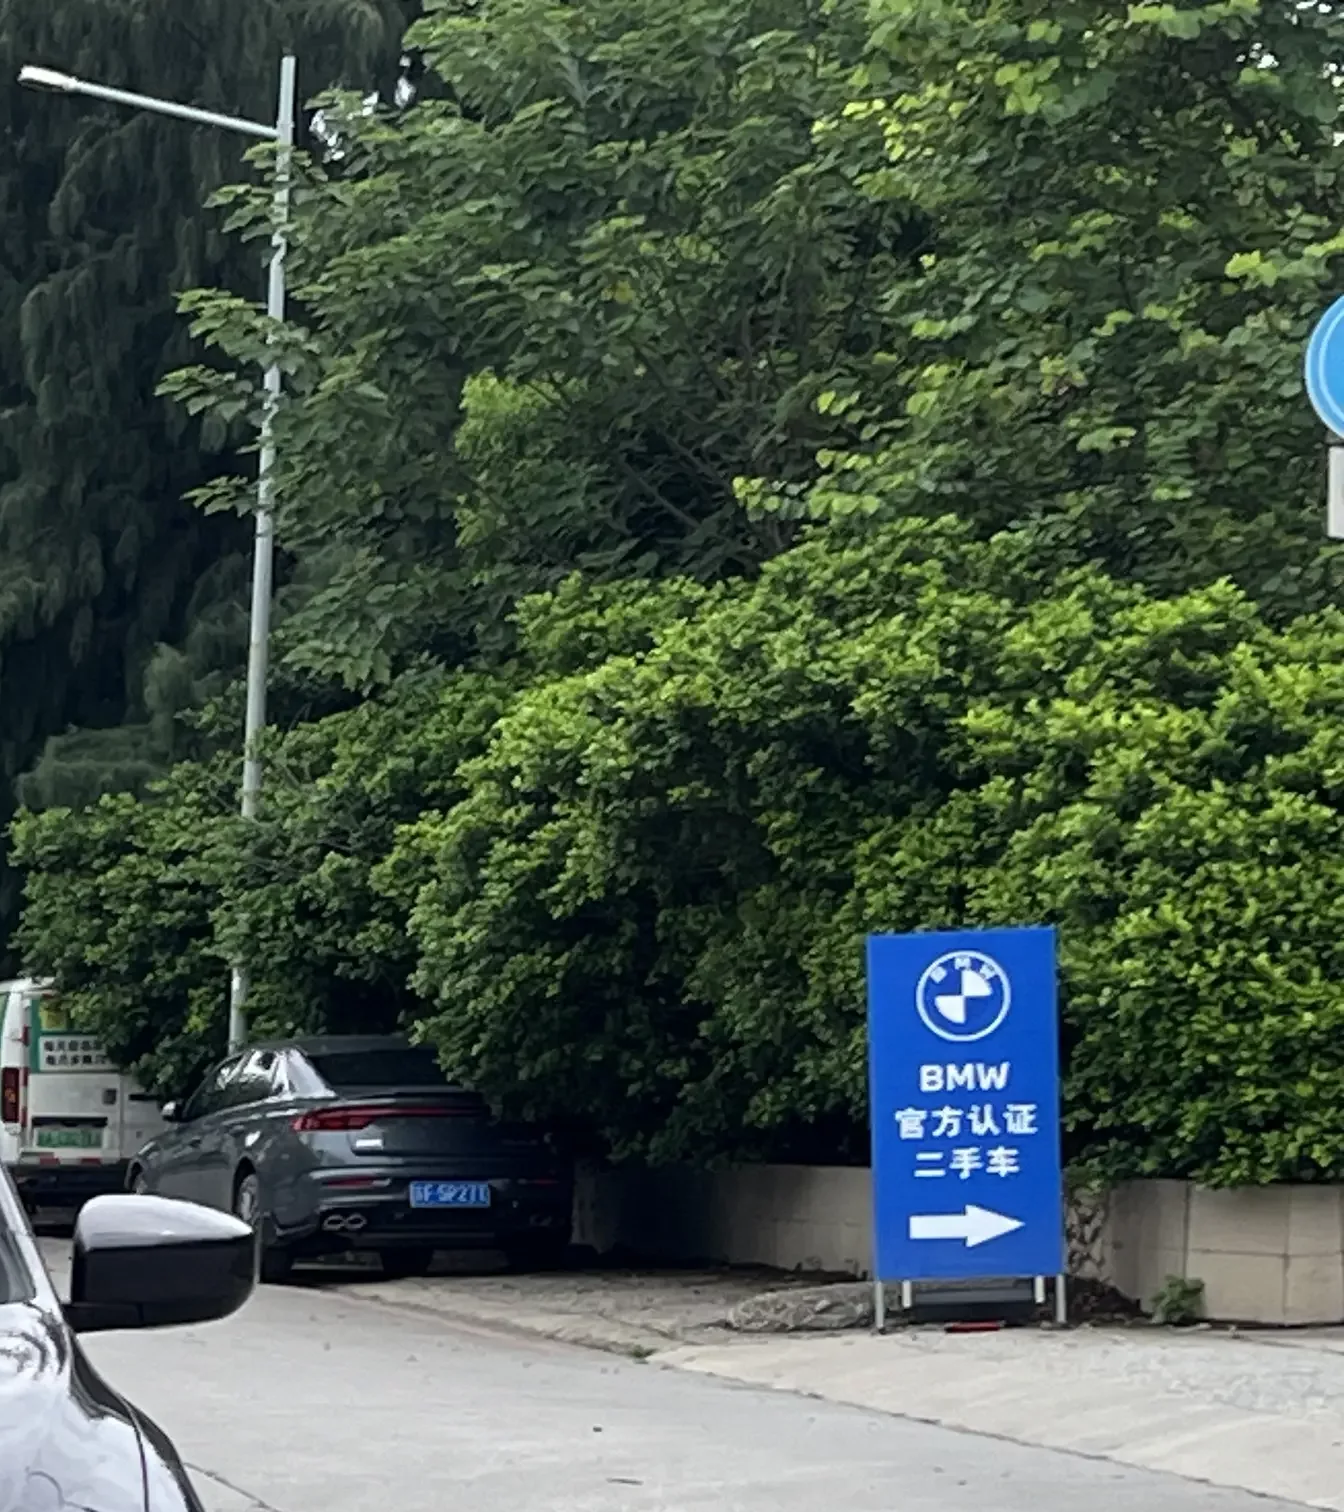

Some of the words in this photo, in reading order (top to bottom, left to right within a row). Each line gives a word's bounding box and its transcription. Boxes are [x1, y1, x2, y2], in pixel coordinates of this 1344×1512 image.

[930, 956, 996, 983] BMW
[920, 1062, 1010, 1092] BMW
[895, 1104, 1038, 1139] 官方认证
[914, 1147, 1020, 1179] 二手车
